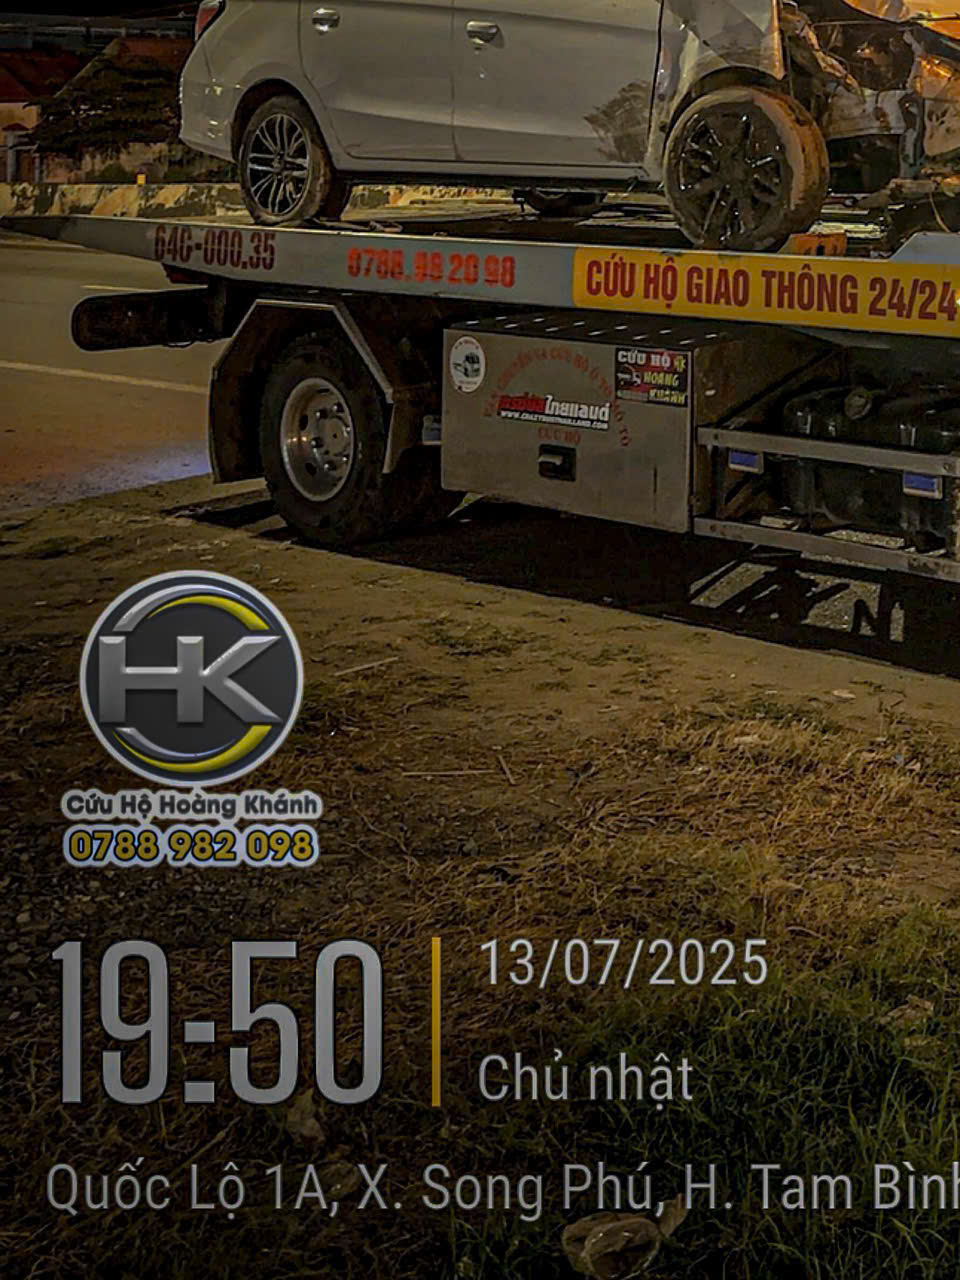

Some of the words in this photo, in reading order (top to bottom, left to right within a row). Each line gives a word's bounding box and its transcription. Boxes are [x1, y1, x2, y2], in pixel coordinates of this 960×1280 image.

[585, 252, 635, 299] CỨU
[643, 256, 678, 311] HỘ
[685, 266, 751, 308] GIAO
[760, 263, 859, 315] THÔNG
[867, 275, 959, 322] 24/24
[616, 348, 647, 365] CỨU
[650, 351, 671, 368] HỘ
